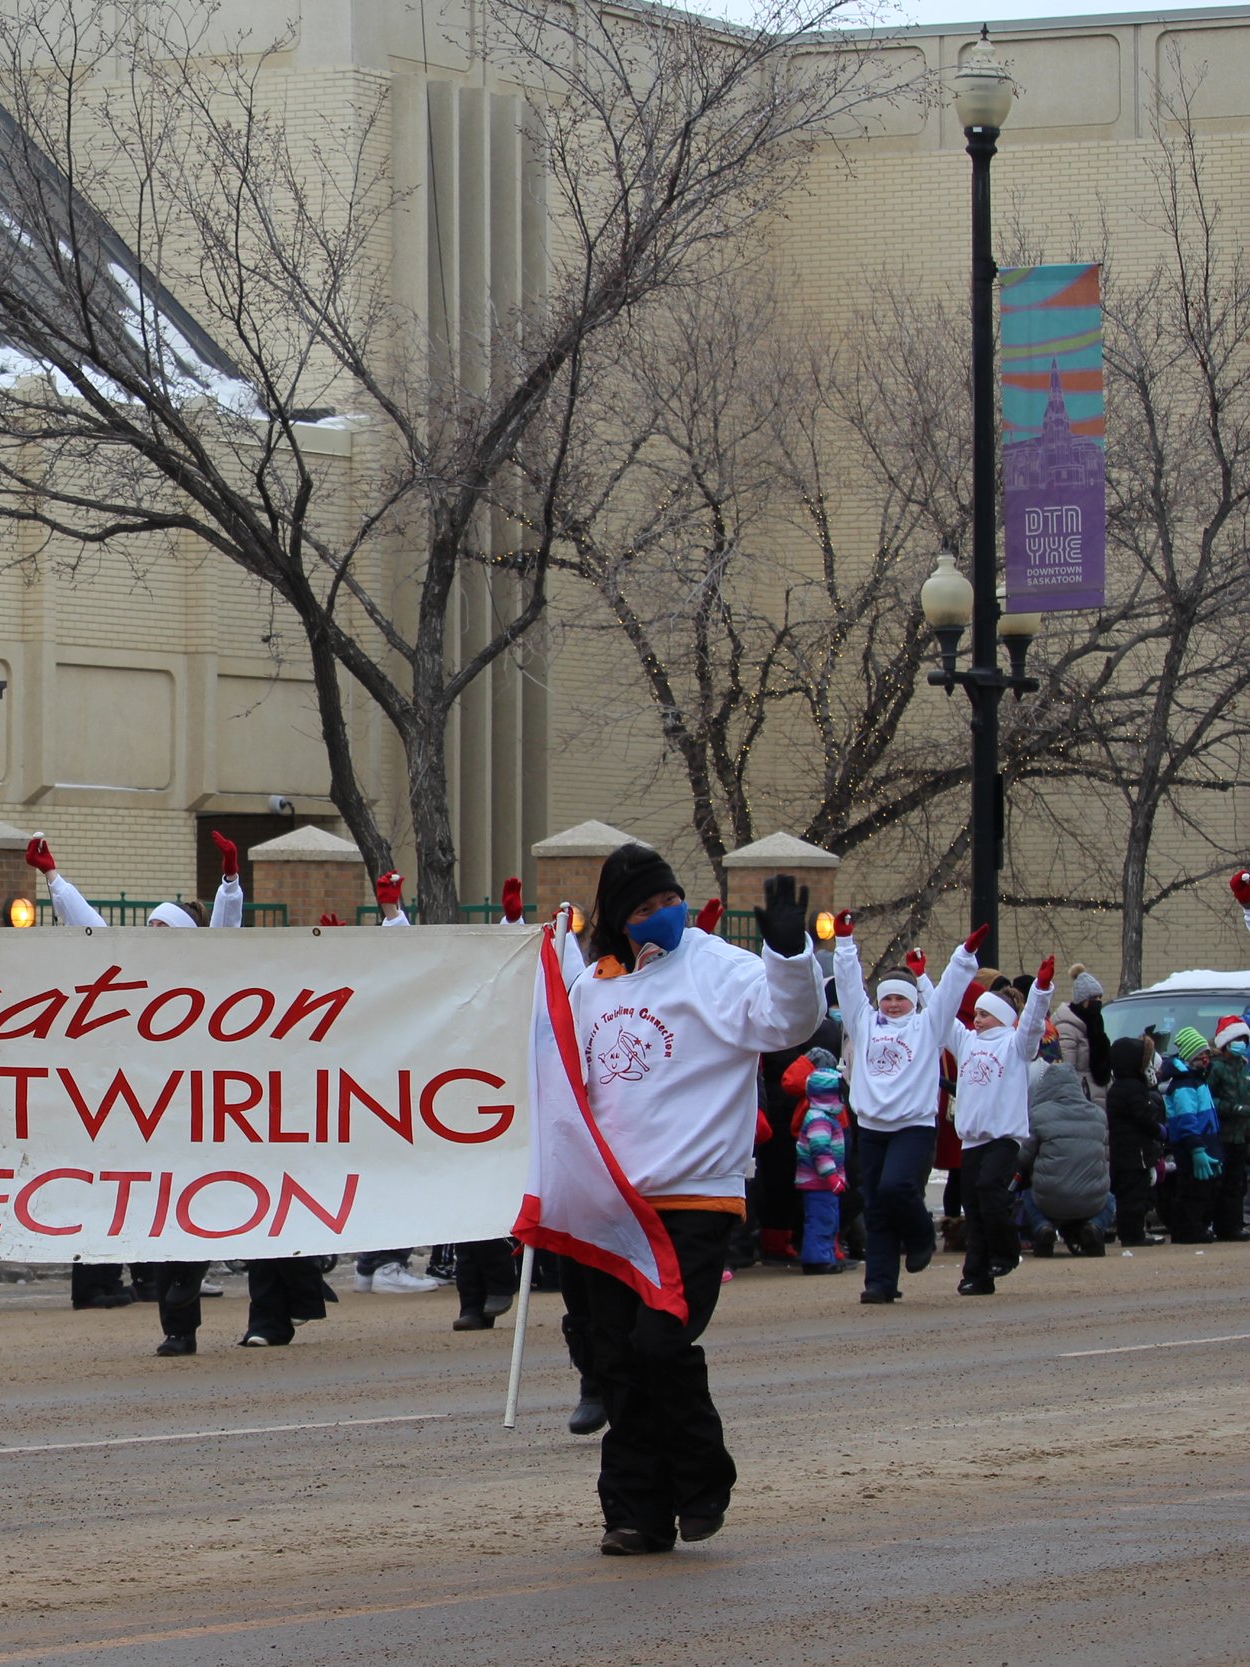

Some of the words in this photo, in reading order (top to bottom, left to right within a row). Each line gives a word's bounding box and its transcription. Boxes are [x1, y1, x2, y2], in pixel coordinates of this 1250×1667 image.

[1025, 505, 1082, 536] DTN
[1026, 535, 1083, 566] YXE
[1026, 565, 1083, 578] DOWNTOWN
[1027, 574, 1083, 587] SASKATOON
[584, 1022, 600, 1072] ptimist
